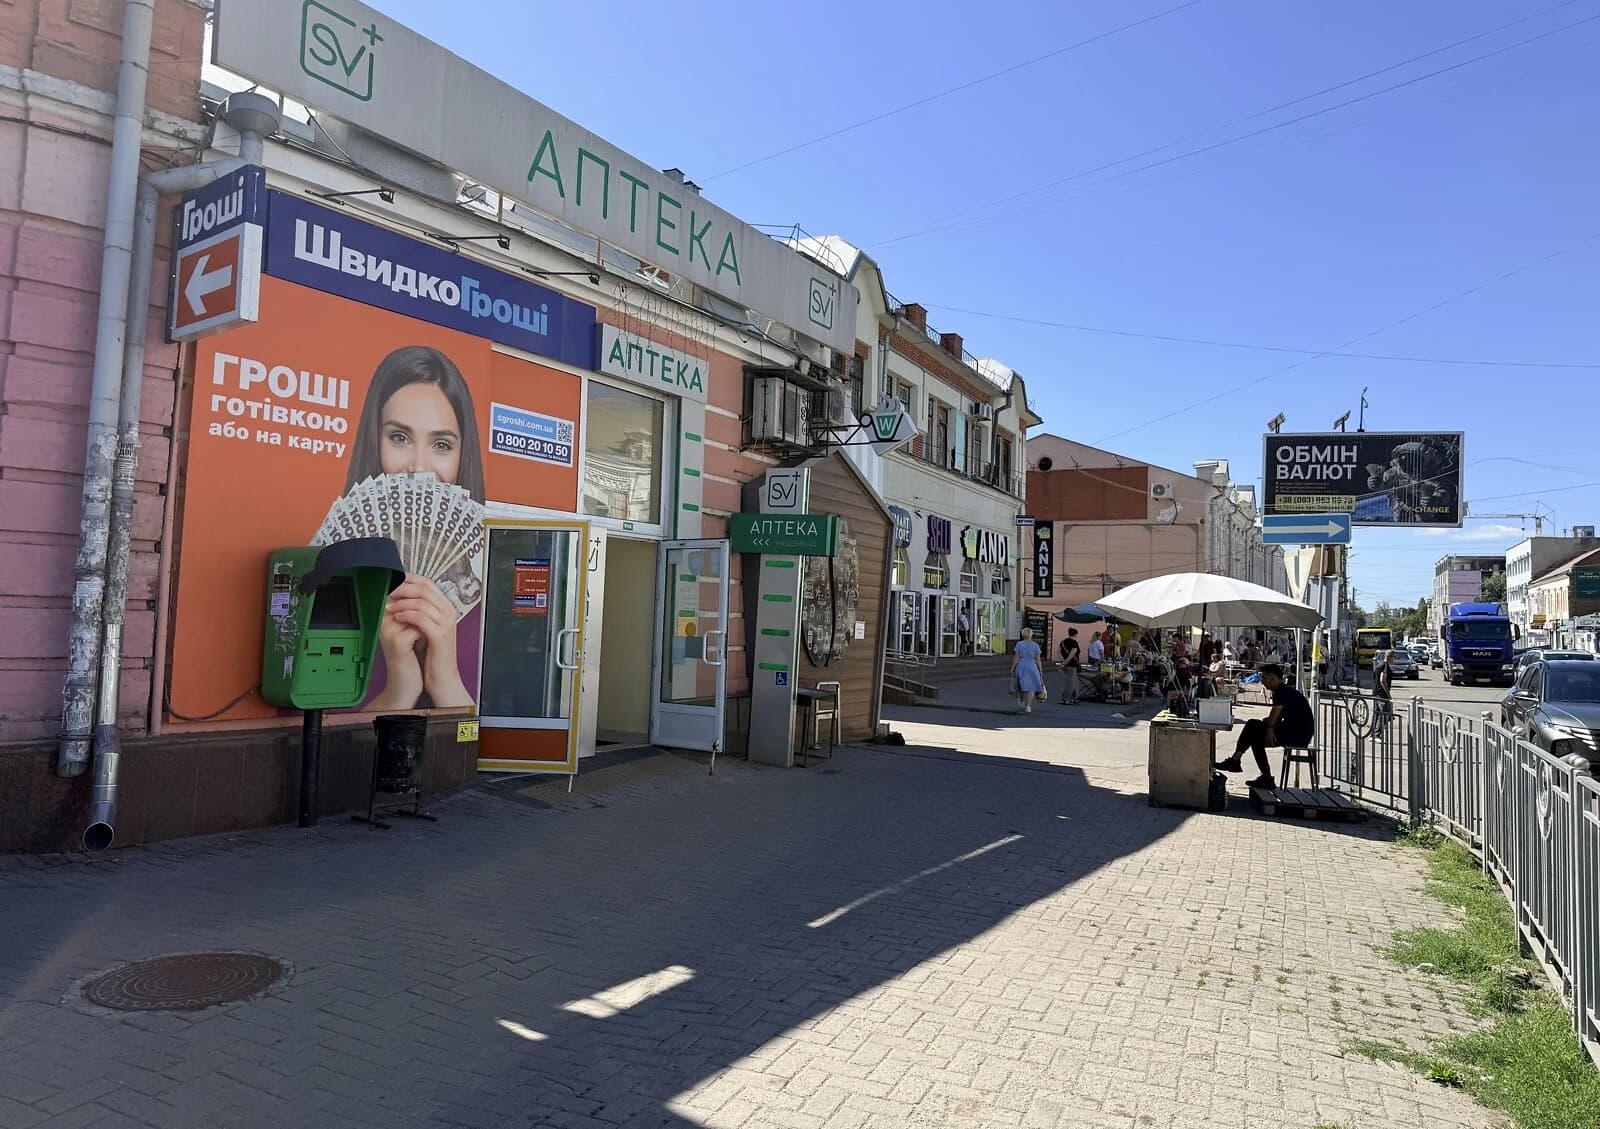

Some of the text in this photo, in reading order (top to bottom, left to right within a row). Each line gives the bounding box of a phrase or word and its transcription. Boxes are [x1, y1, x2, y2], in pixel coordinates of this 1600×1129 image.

[182, 175, 244, 241] Гроші
[527, 129, 741, 286] АПТЕКА
[294, 218, 549, 336] ШвидкоГроші
[213, 352, 350, 410] ГРОШІ
[608, 338, 703, 393] АПТЕКА
[211, 394, 348, 434] готівкою
[496, 413, 554, 433] sgroshi.com.ua
[208, 421, 346, 458] або на карту
[497, 432, 505, 444] 0
[505, 435, 526, 449] 800
[528, 439, 541, 452] 20
[543, 442, 554, 454] 10
[555, 445, 568, 457] 50
[1275, 445, 1358, 463] ОБМІН
[1275, 464, 1357, 480] ВАЛЮТ
[750, 520, 818, 536] АПТЕКА
[1039, 541, 1049, 589] ANDI
